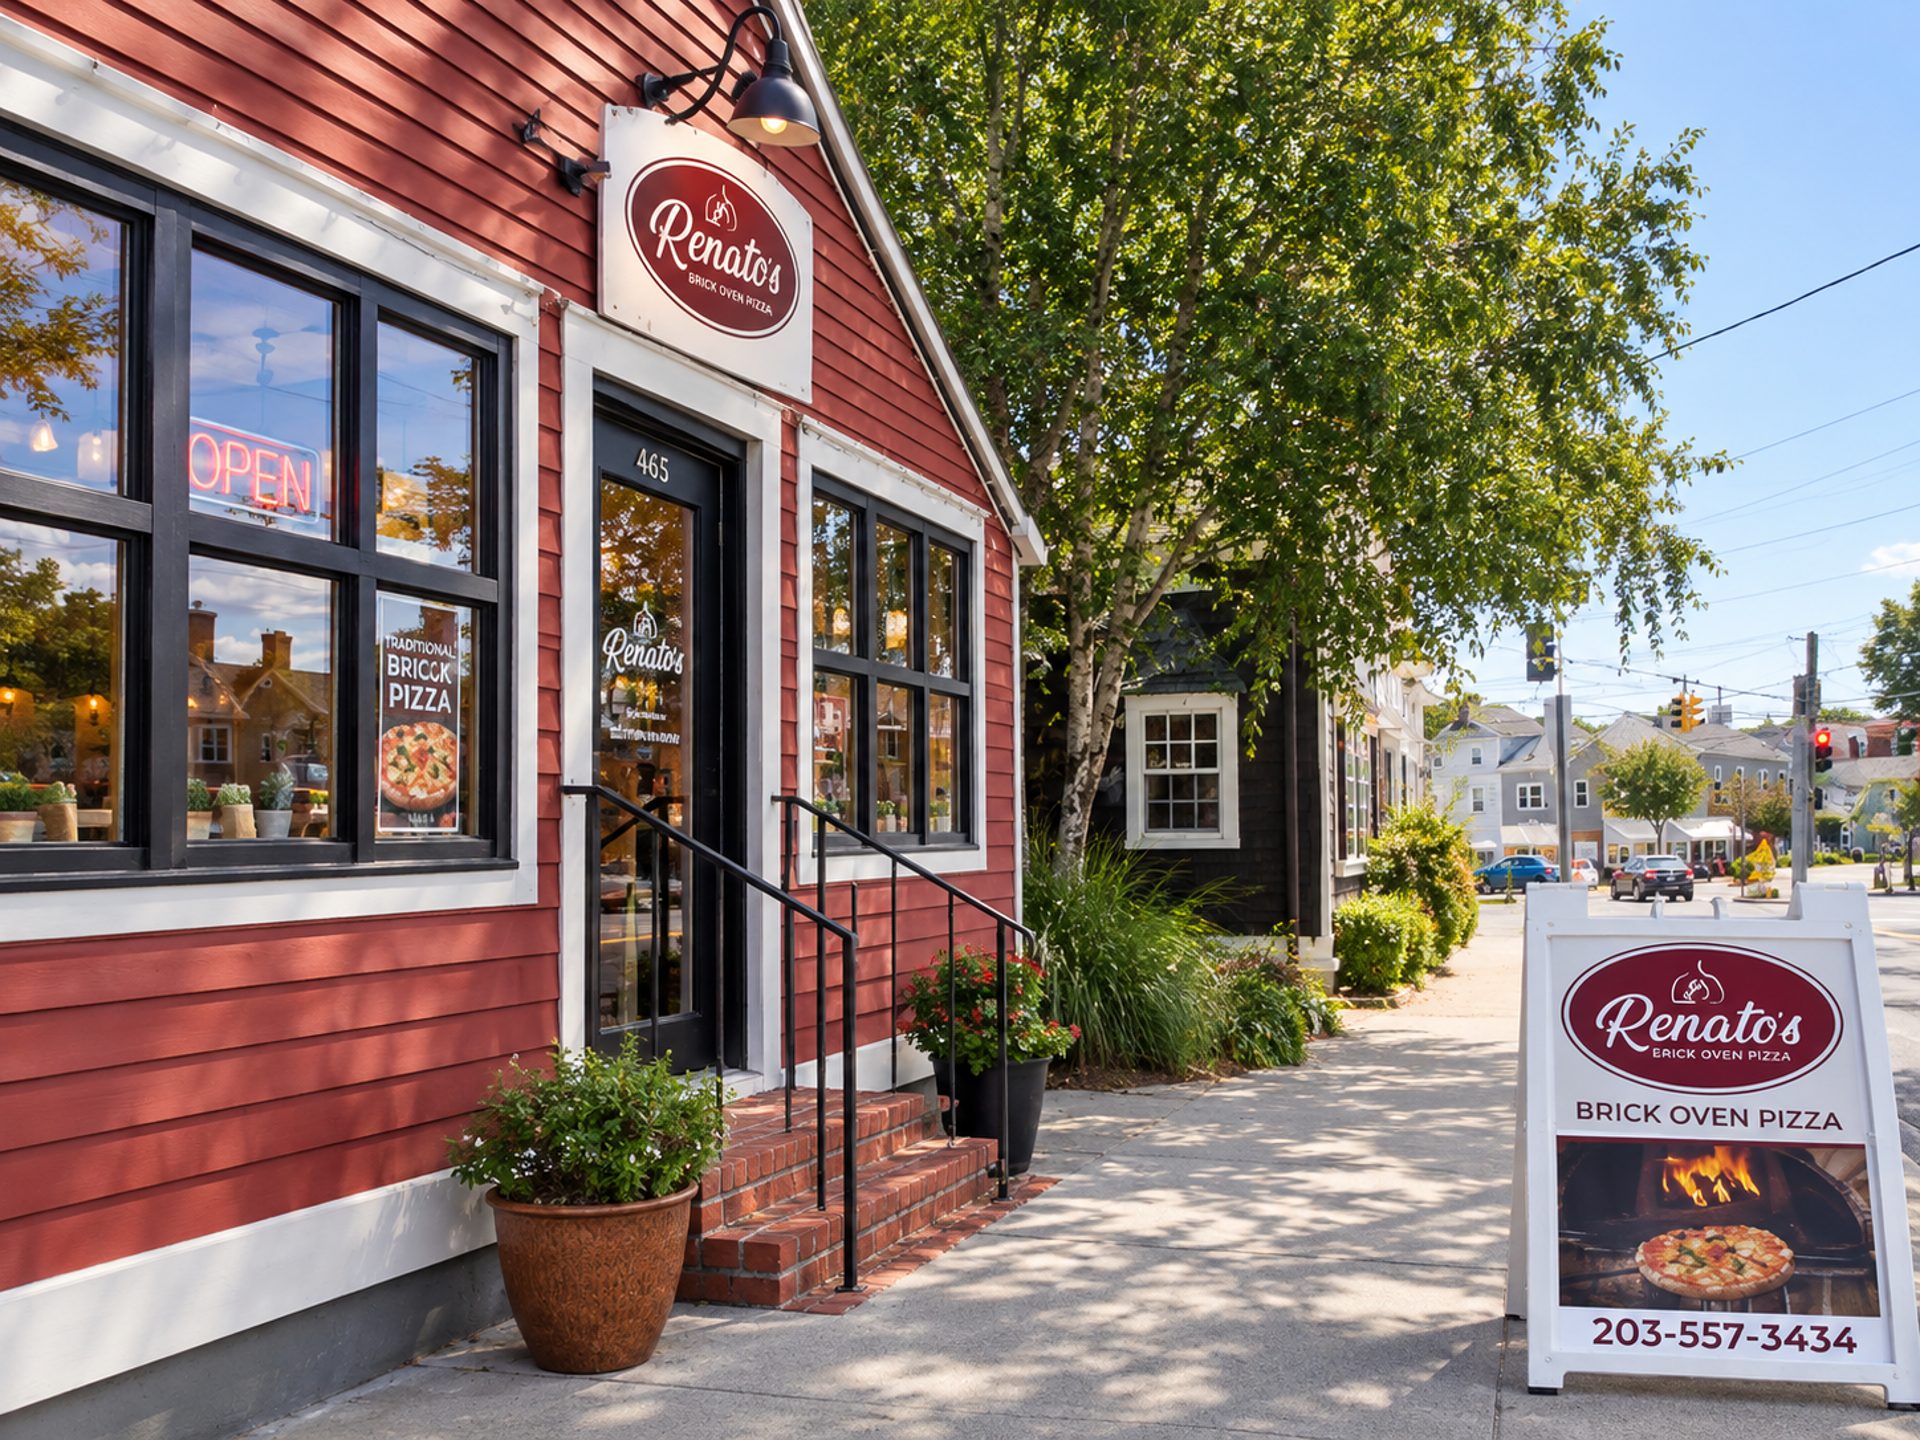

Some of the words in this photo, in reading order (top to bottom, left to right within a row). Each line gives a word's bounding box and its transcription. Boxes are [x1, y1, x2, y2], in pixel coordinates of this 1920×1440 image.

[649, 199, 782, 295] Renato's
[688, 272, 717, 293] BRICK
[719, 285, 744, 304] OVEN
[746, 295, 773, 317] PIZZA
[189, 432, 311, 513] OPEN
[637, 448, 669, 483] 465
[603, 627, 685, 675] Renato's
[388, 682, 452, 714] PIZZA
[1595, 993, 1803, 1052] Renato's
[1652, 1047, 1696, 1060] BRICK
[1701, 1049, 1742, 1061] OVEN
[1748, 1050, 1791, 1062] PIZZA
[1576, 1101, 1662, 1125] BRICK
[1669, 1104, 1749, 1128] OVEN
[1759, 1108, 1844, 1131] PIZZA
[1592, 1317, 1858, 1354] 203-557-3434
